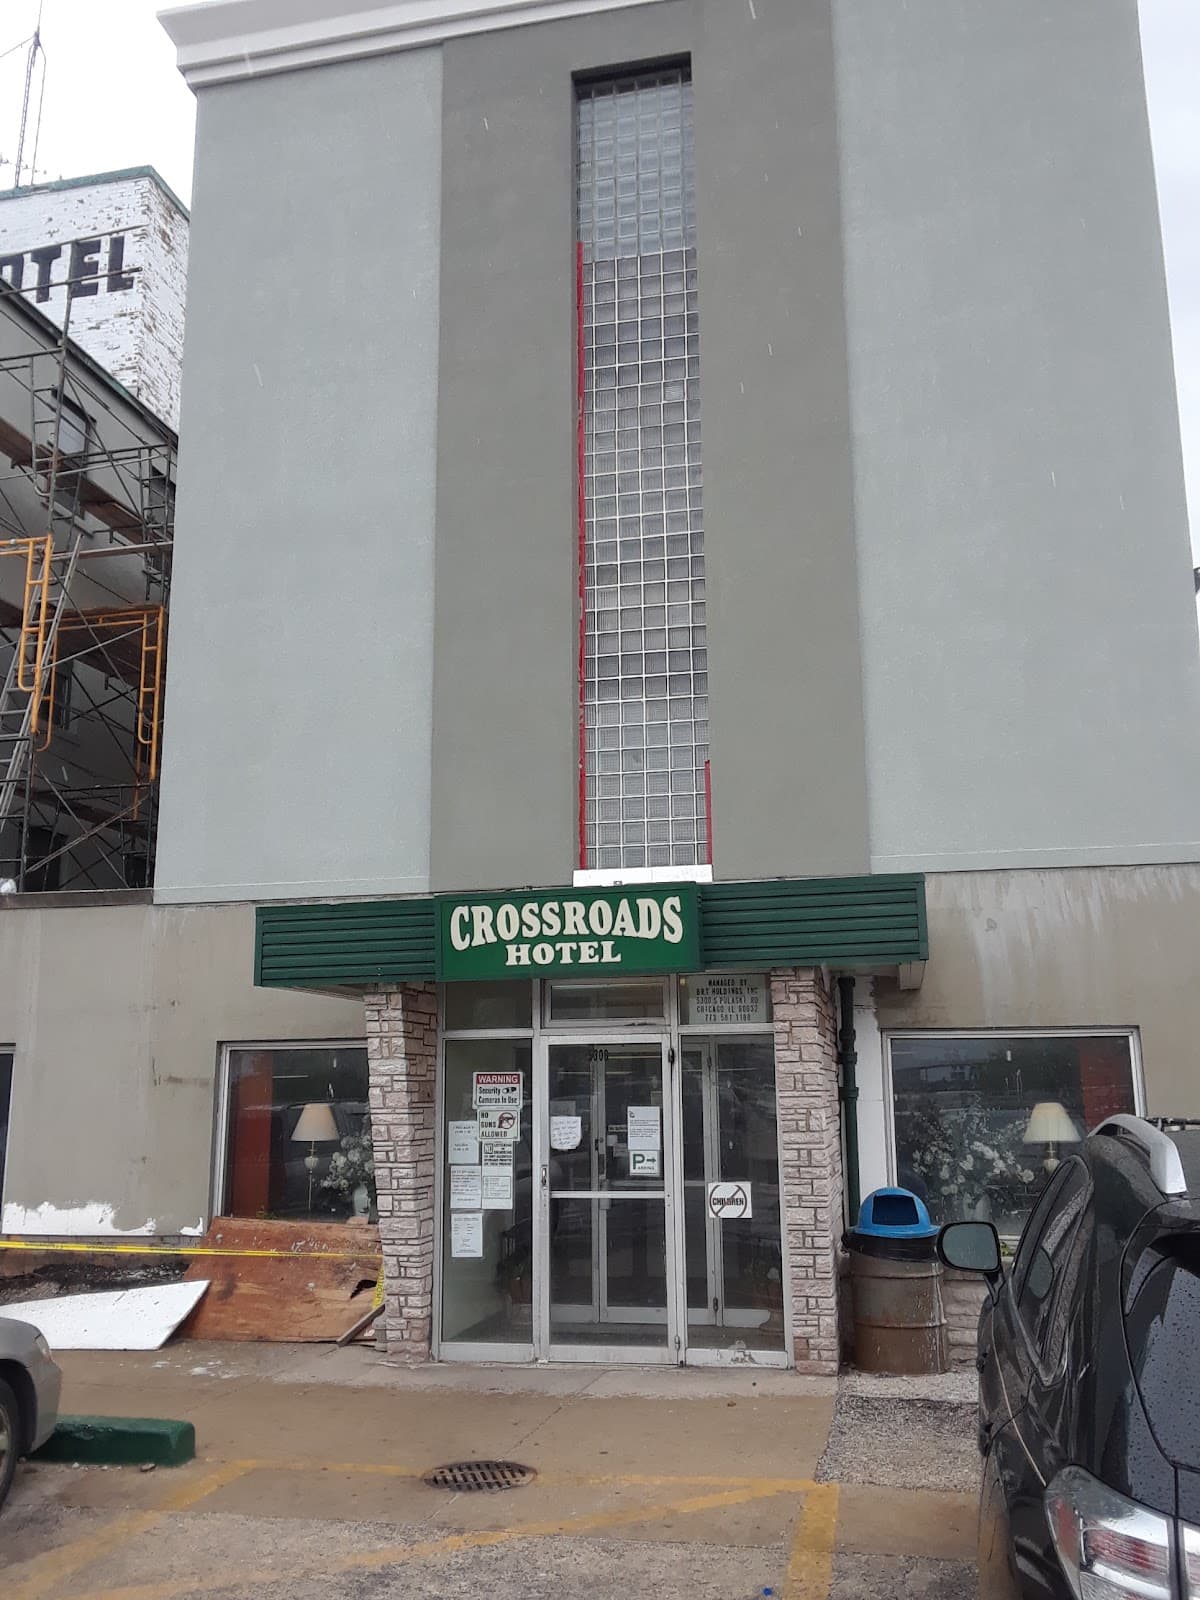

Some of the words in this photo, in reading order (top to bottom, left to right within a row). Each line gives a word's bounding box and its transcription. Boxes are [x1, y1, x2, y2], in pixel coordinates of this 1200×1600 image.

[450, 896, 683, 951] CROSSROADS
[505, 940, 622, 966] HOTEL
[712, 987, 743, 995] HOLDINGS
[696, 1005, 724, 1013] CHICAGO
[478, 1074, 519, 1084] WARNING
[478, 1086, 501, 1096] Security
[478, 1096, 500, 1104] Cameras
[501, 1096, 507, 1104] In
[508, 1096, 518, 1104] Use
[480, 1121, 496, 1129] GUNS
[480, 1130, 508, 1138] ALLOWED
[712, 1197, 745, 1206] CHILDREN
